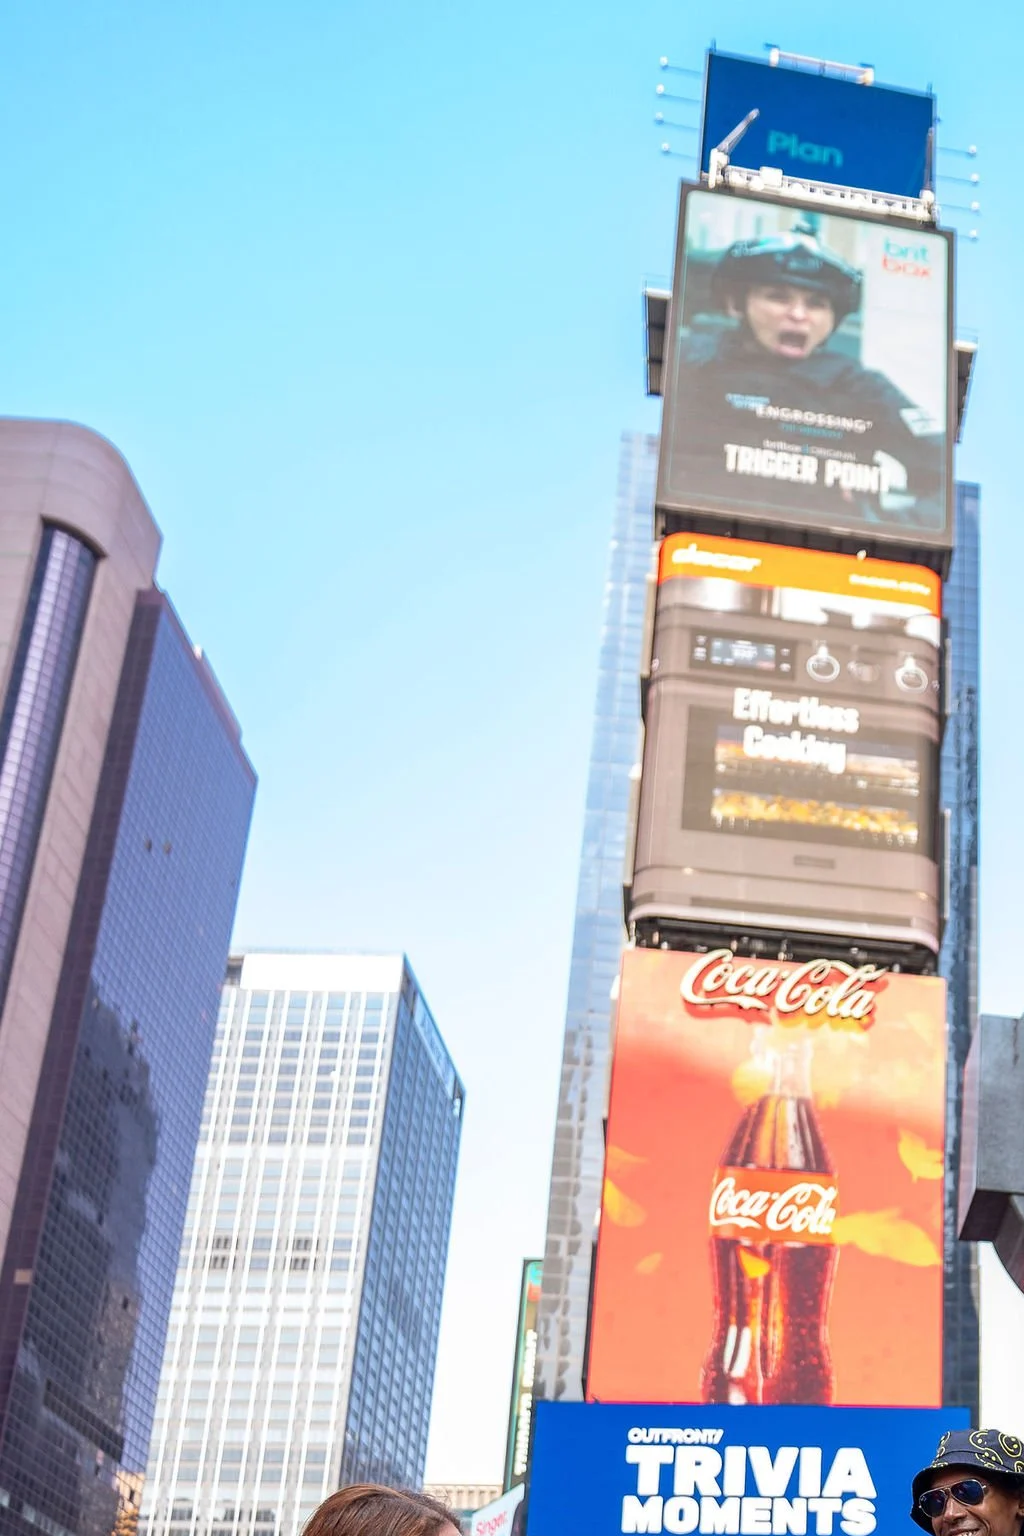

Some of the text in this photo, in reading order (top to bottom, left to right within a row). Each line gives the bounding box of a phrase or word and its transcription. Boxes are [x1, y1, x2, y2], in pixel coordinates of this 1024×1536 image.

[767, 130, 844, 168] Plan
[724, 443, 890, 494] TRIGGER POINT
[733, 687, 860, 734] Effortless
[743, 725, 847, 775] Cooking
[680, 948, 888, 1020] Coca-Cola
[625, 1445, 878, 1499] TRIVIA
[621, 1495, 878, 1536] MOMENTS
